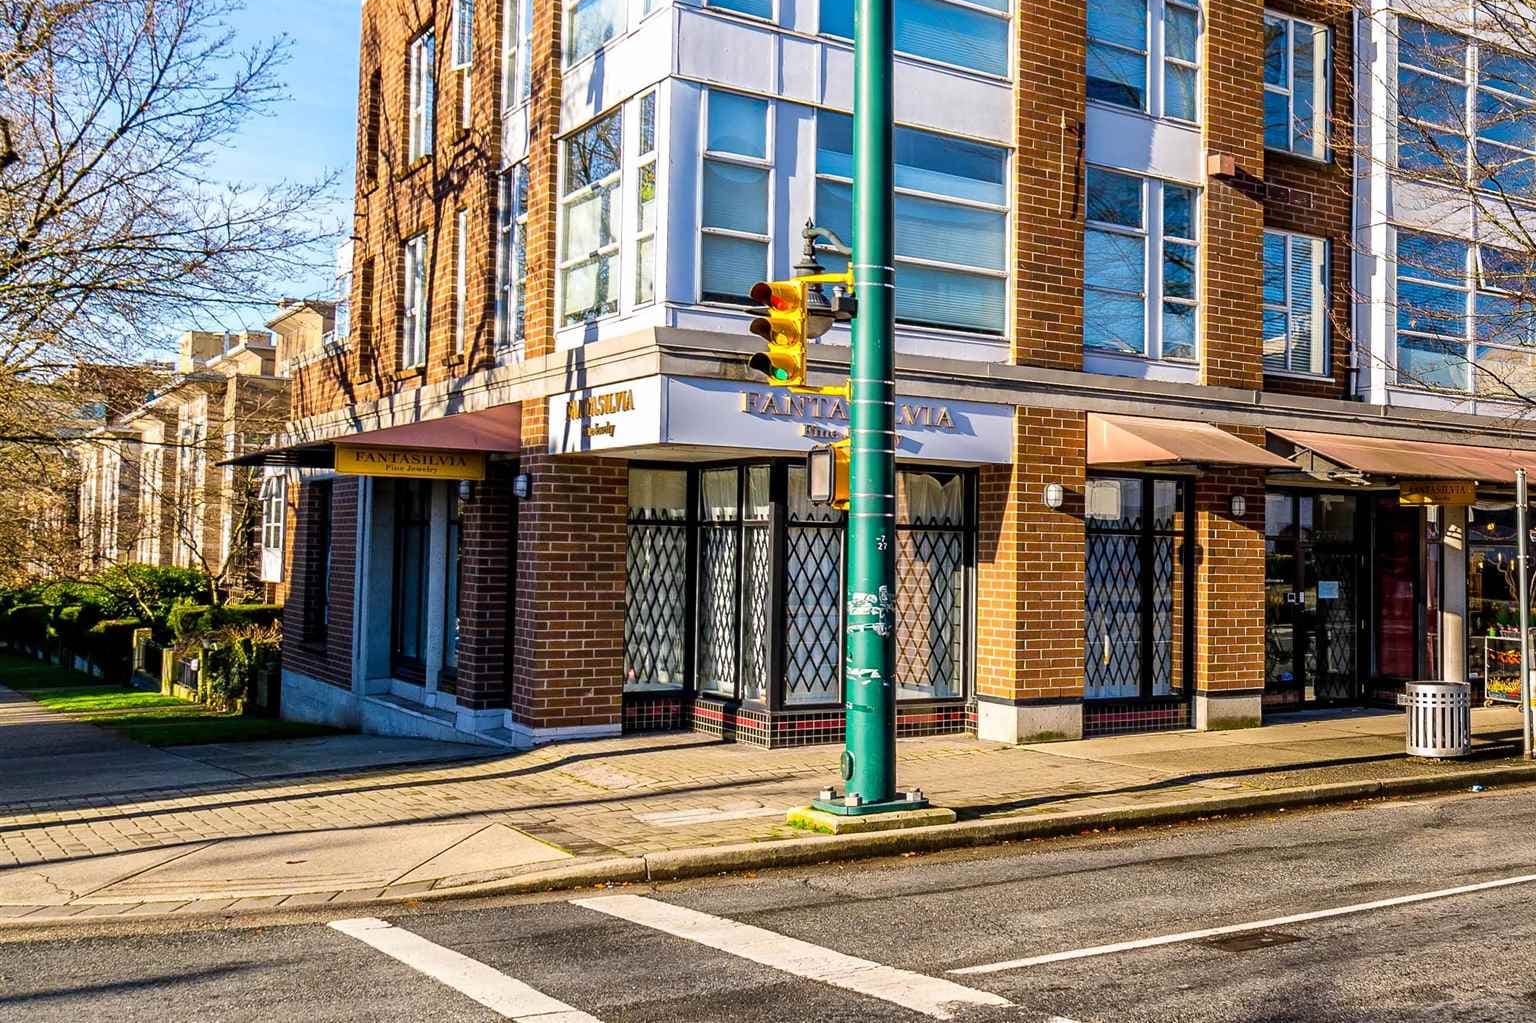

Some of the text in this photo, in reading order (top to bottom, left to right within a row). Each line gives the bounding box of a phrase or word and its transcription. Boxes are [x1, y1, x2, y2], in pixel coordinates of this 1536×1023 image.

[740, 390, 954, 428] FANTAVIA
[355, 450, 467, 466] FANTASILVIA
[385, 463, 438, 473] Fine Jewelry
